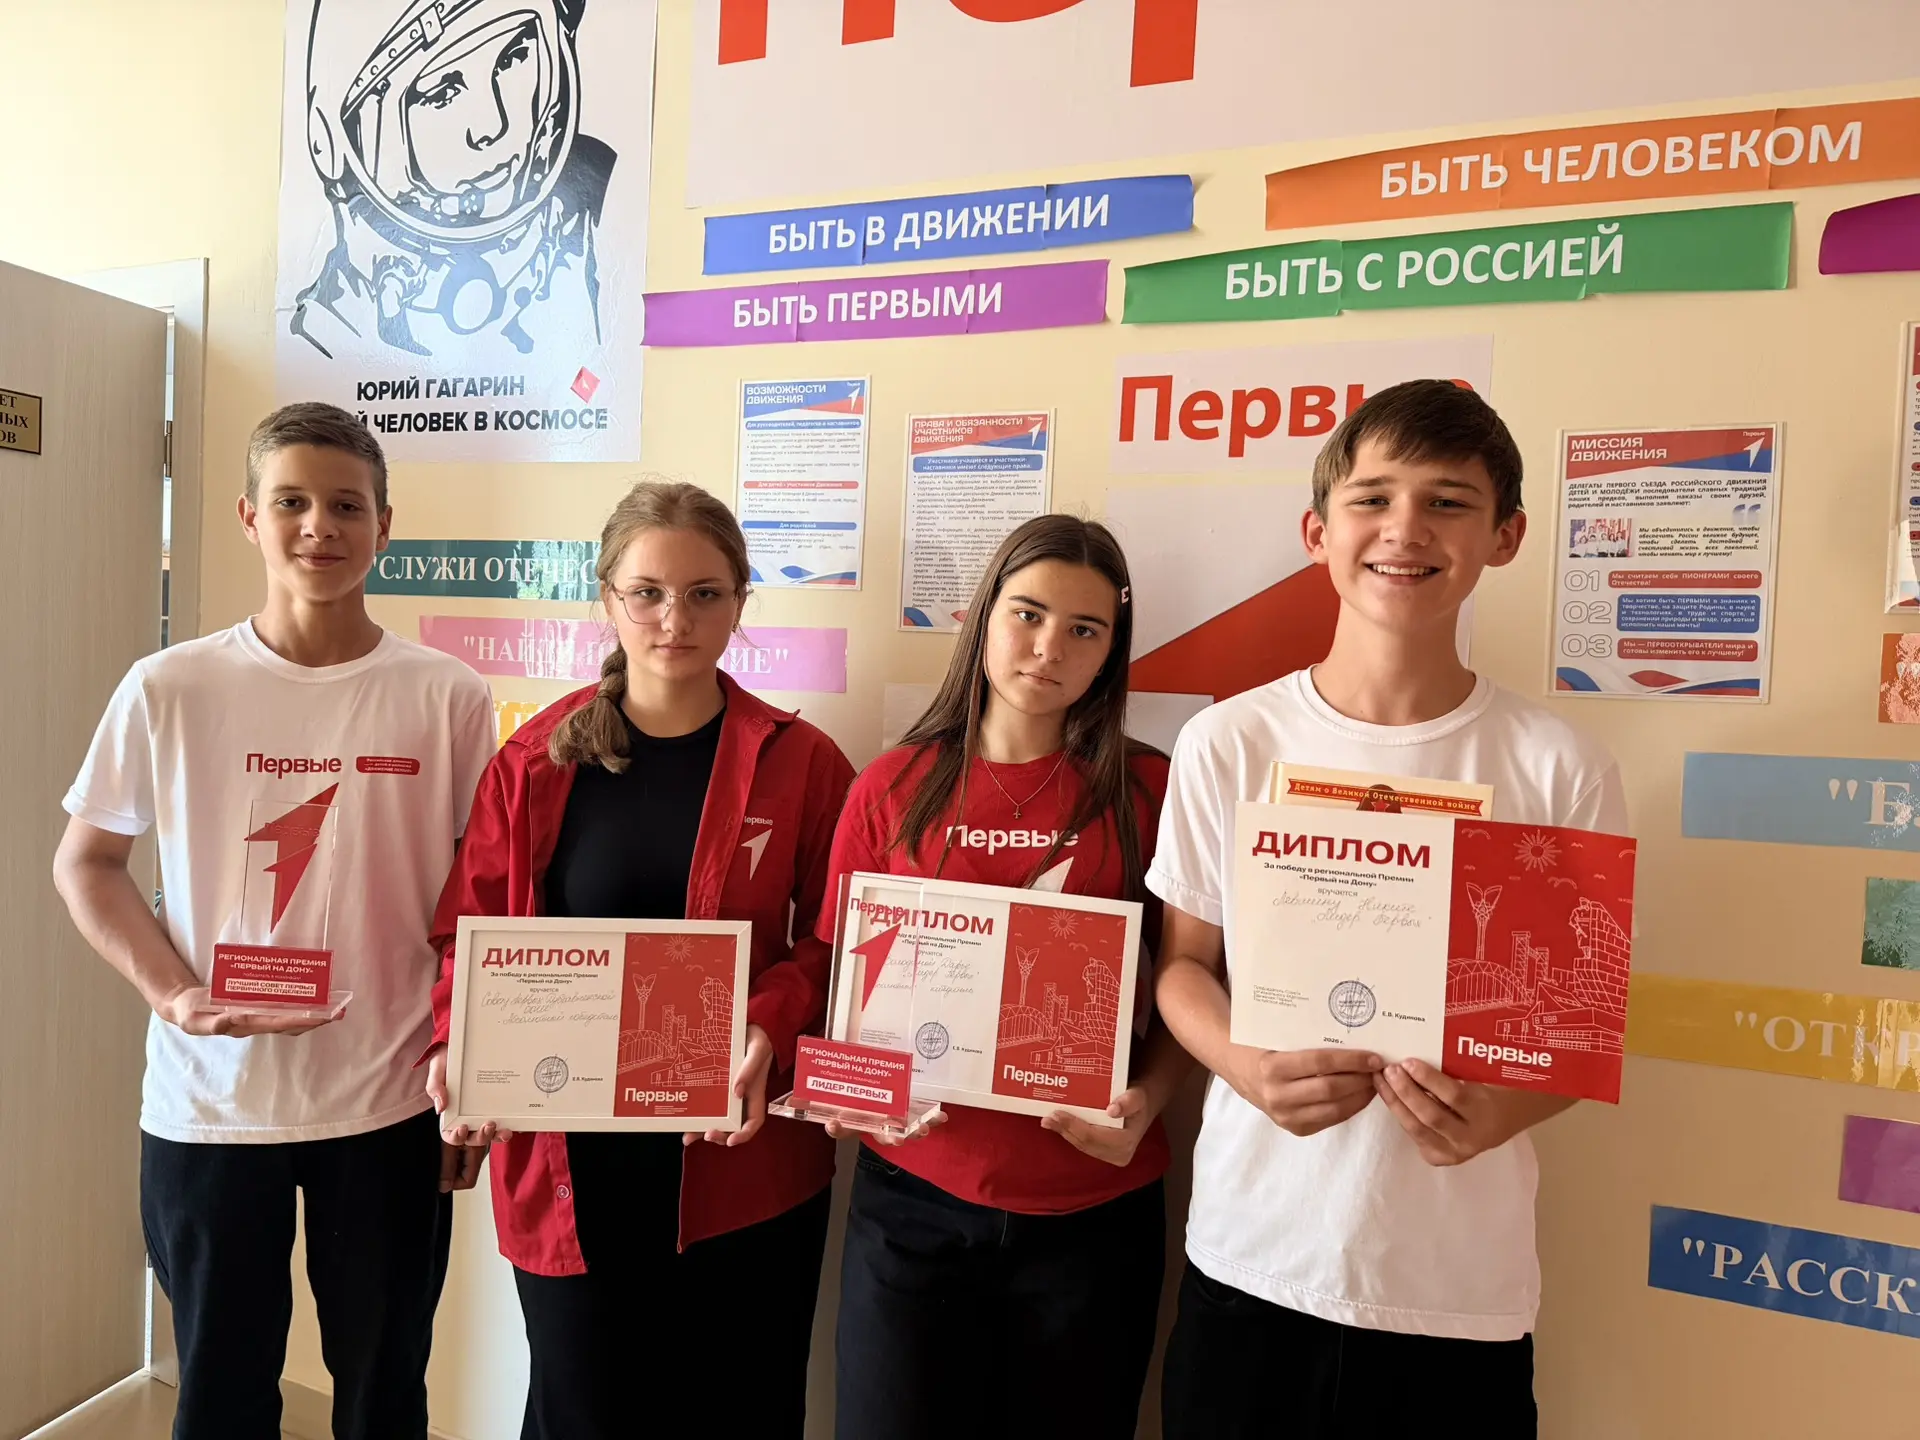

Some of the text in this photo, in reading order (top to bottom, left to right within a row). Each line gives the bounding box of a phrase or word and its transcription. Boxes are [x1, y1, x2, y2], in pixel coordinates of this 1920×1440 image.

[1380, 120, 1863, 200] БЫТЬ ЧЕЛОВЕКОМ
[768, 193, 1110, 254] БЫТЬ В ДВИЖЕНИИ
[1225, 221, 1624, 300] БЫТЬ С РОССИЕЙ
[733, 281, 1003, 330] БЫТЬ ПЕРВЫМИ
[357, 375, 525, 401] ЮРИЙ ГАГАРИН
[746, 384, 827, 395] ВОЗМОЖНОСТИ
[746, 395, 804, 405] ДВИЖЕНИЯ
[374, 411, 468, 434] ЧЕЛОВЕК
[474, 411, 488, 432] В
[494, 408, 608, 431] КОСМОСЕ
[914, 420, 945, 428] ПРАВА
[955, 418, 1023, 427] ОБЯЗАННОСТИ
[1119, 374, 1474, 457] Перв
[913, 435, 964, 444] ДВИЖЕНИЯ
[1571, 437, 1643, 450] МИССИЯ
[1570, 448, 1667, 462] ДВИЖЕНИЯ
[1564, 569, 1599, 592] 01
[1562, 600, 1612, 624] 02
[1561, 633, 1613, 658] 03
[1647, 641, 1724, 649] ПЕРВООТКРЫВАТЕЛИ
[246, 753, 342, 779] Первые
[1294, 783, 1322, 795] Детям
[1332, 786, 1370, 799] Великой
[1373, 791, 1443, 808] Отечественной
[1447, 801, 1476, 812] войне
[1252, 831, 1431, 868] ДИПЛОМ
[1276, 865, 1307, 873] победу
[1314, 868, 1376, 879] региональной
[1378, 873, 1414, 883] Премии
[1299, 874, 1337, 883] «Первый
[1351, 879, 1377, 887] Дону»
[1318, 888, 1358, 897] вручается
[870, 906, 994, 935] ДИПЛОМ
[957, 938, 982, 946] Премии
[218, 953, 327, 967] РЕГИОНАЛЬНАЯ ПРЕМИЯ
[230, 962, 314, 974] «ПЕРВЫЙ НА ДОНУ»
[482, 947, 610, 968] ДИПЛОМ
[227, 985, 273, 993] ПЕРВИЧНОГО
[228, 979, 259, 987] ЛУЧШИЙ
[285, 983, 314, 991] ПЕРВЫХ
[800, 1046, 905, 1070] РЕГИОНАЛЬНАЯ ПРЕМИЯ
[1457, 1036, 1553, 1067] Первые
[811, 1058, 850, 1070] «ПЕРВЫЙ
[864, 1068, 892, 1077] ДОНУ»
[1003, 1064, 1069, 1088] Первые
[624, 1087, 689, 1106] Первые
[811, 1079, 888, 1100] ЛИДЕР ПЕРВЫХ
